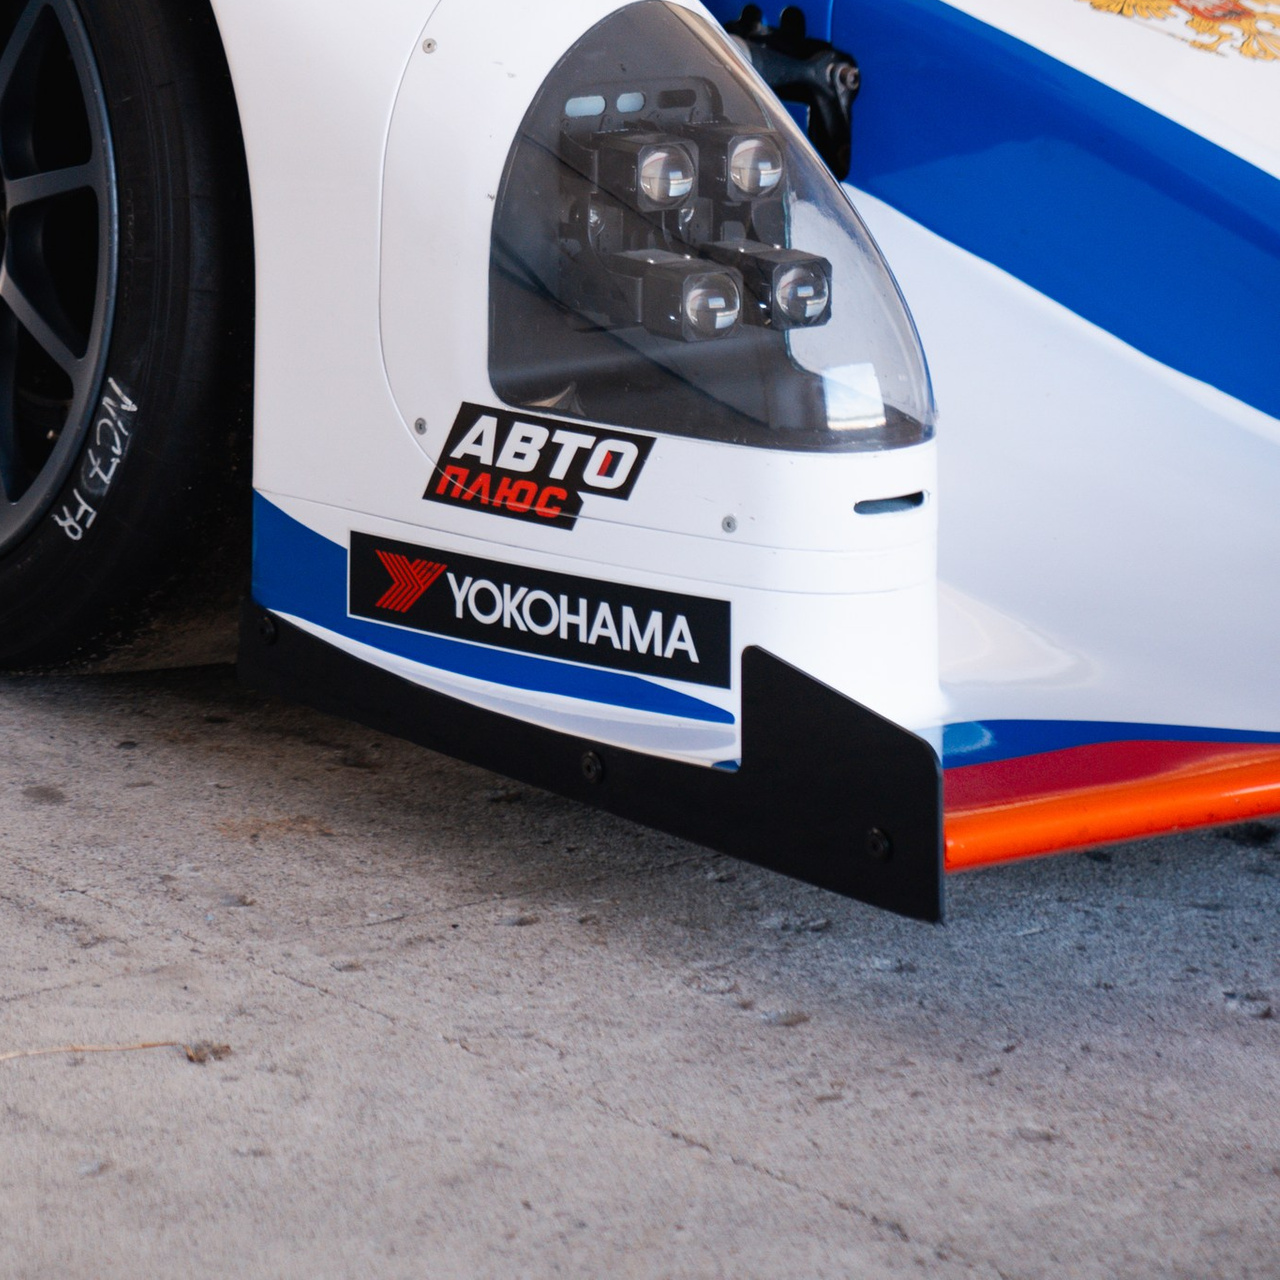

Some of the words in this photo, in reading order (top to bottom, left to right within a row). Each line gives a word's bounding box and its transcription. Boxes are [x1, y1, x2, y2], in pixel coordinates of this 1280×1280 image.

[88, 376, 138, 485] NC7
[450, 415, 639, 490] АВТО
[51, 488, 98, 541] FR
[436, 465, 568, 518] ПЛЮС
[446, 572, 700, 663] YOKOHAMA
